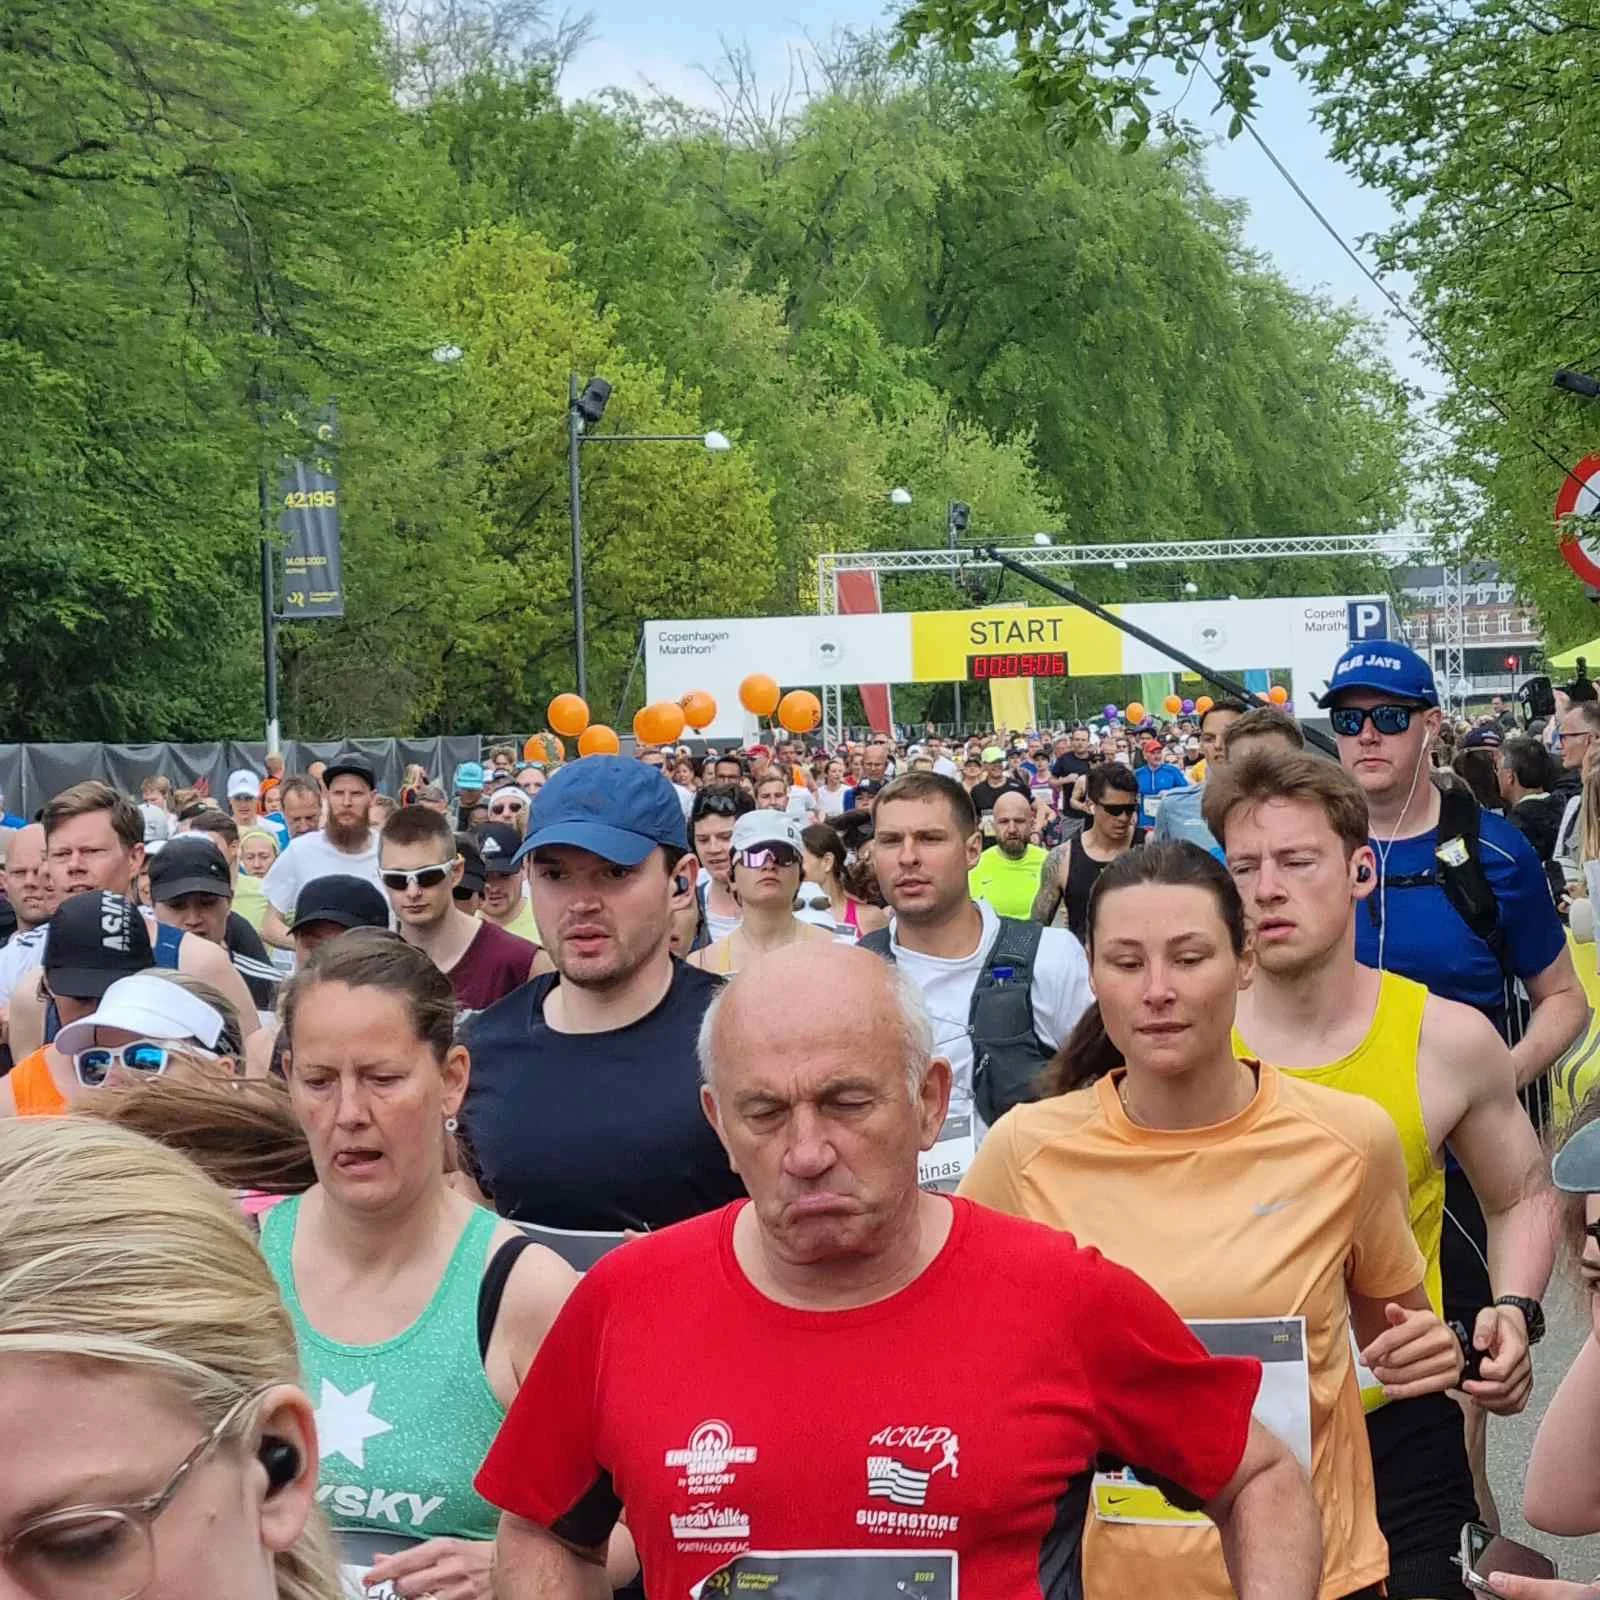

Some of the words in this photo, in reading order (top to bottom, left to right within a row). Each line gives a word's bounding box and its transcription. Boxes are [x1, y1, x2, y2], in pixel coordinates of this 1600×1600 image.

[969, 619, 1063, 645] START
[1355, 604, 1381, 639] P
[658, 631, 729, 643] Copenhagen
[1365, 654, 1402, 670] JAYS
[868, 1425, 952, 1453] ACRLP
[687, 1475, 702, 1487] GO
[703, 1473, 736, 1486] SPORT
[856, 1509, 960, 1532] SUPERSTORE
